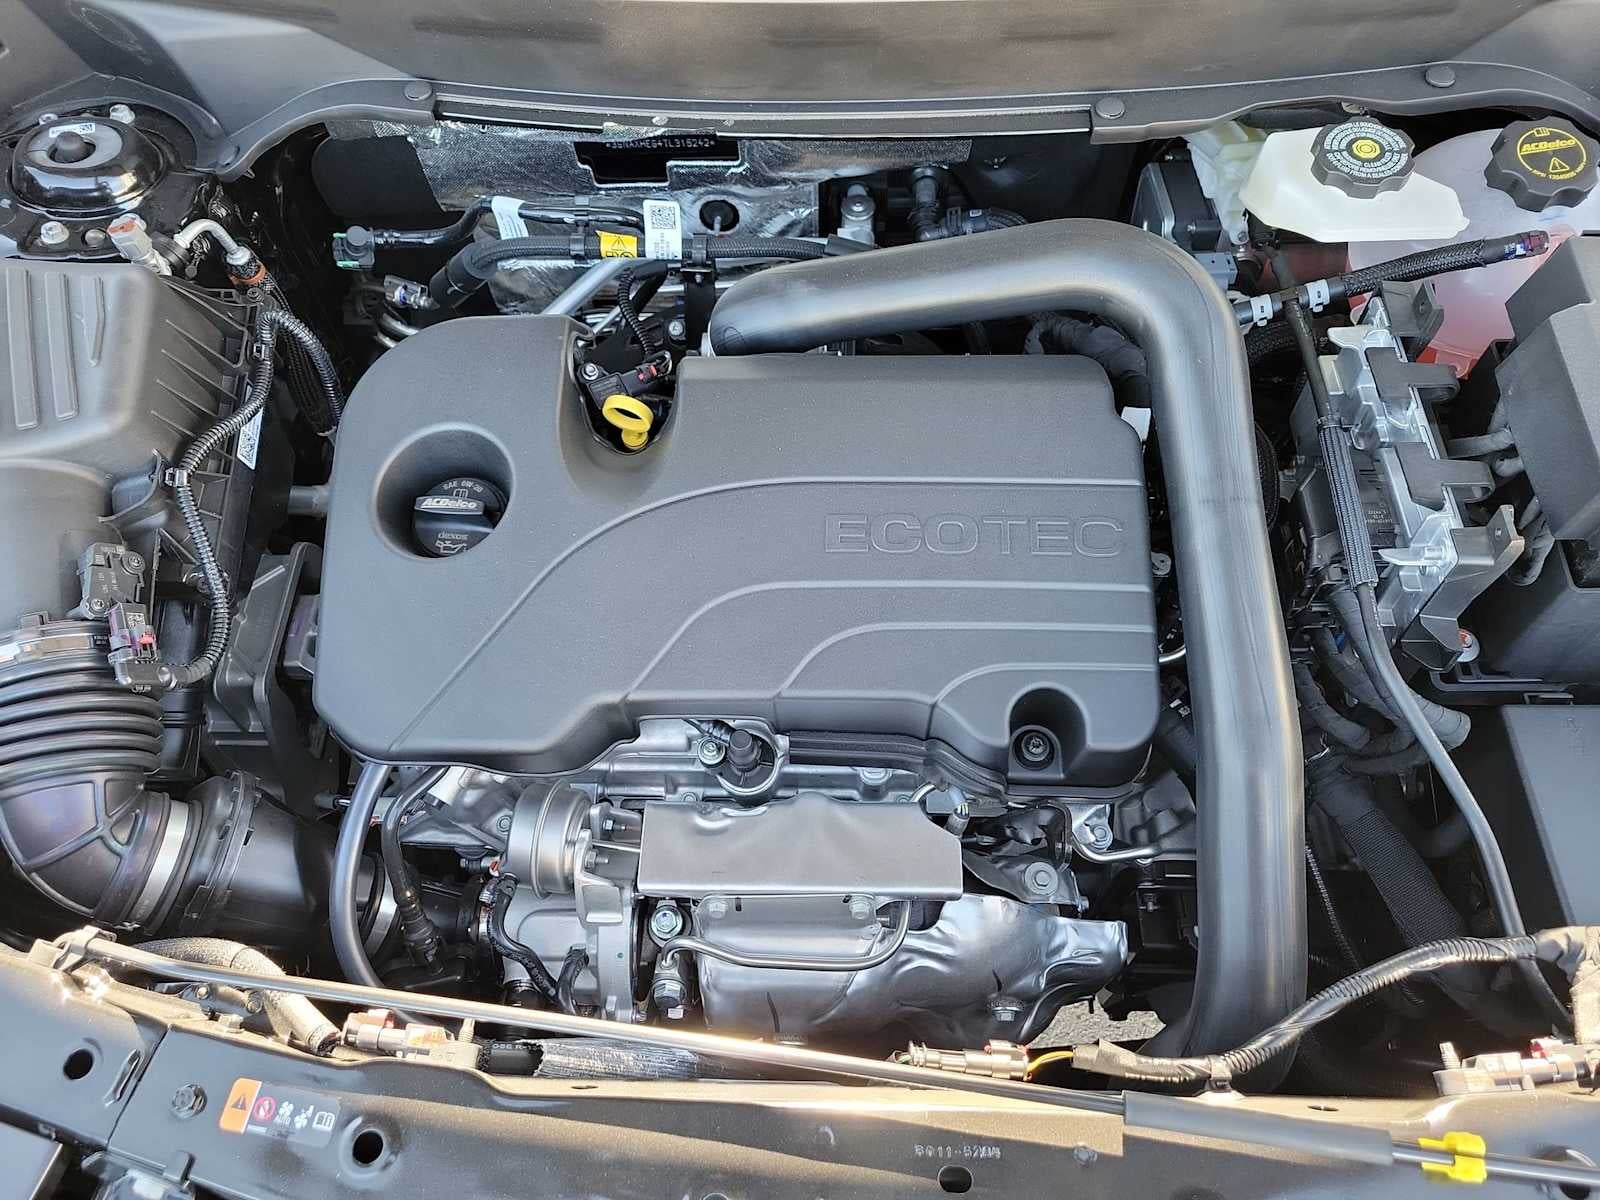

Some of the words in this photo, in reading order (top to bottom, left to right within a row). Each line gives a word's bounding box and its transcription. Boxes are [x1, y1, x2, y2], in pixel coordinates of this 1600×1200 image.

[1521, 139, 1576, 153] ACDelco
[422, 498, 477, 509] ACDelco
[824, 512, 1124, 558] ECOTEC
